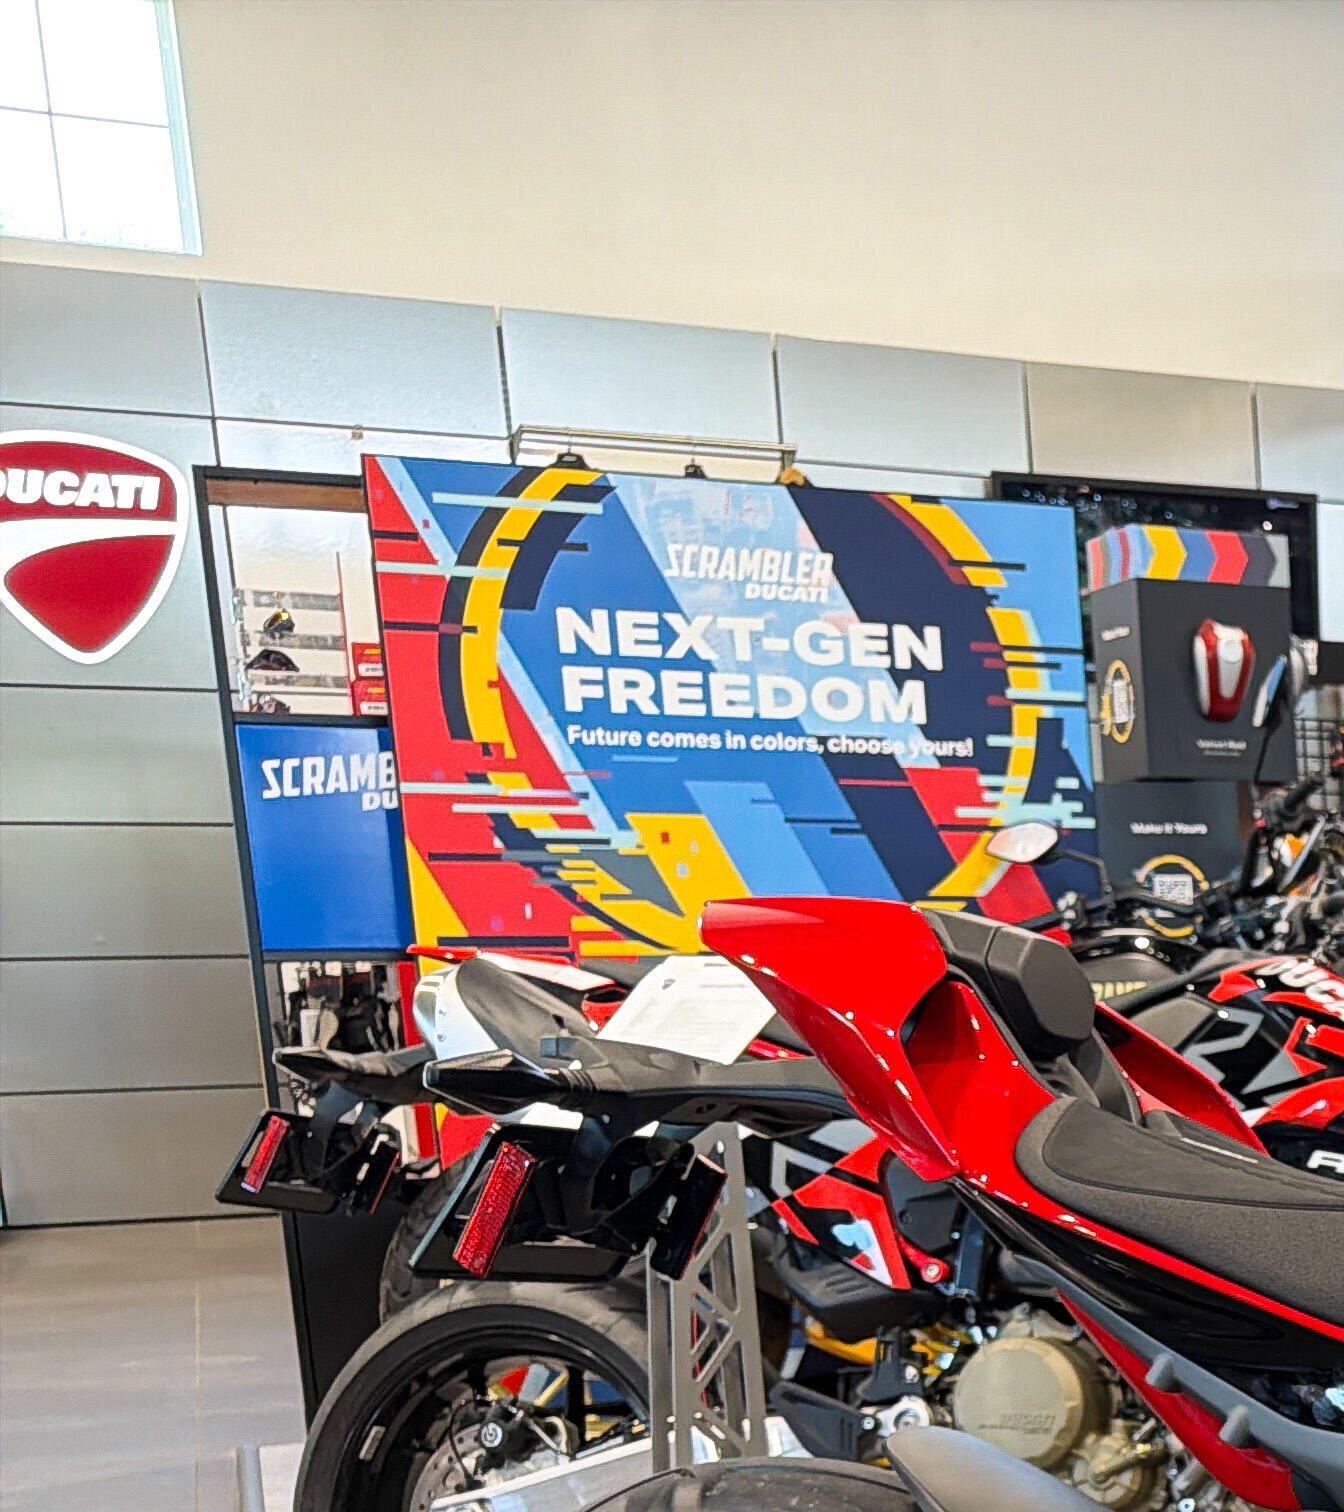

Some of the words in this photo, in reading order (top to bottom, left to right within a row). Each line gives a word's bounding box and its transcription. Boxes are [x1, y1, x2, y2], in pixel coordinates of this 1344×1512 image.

[0, 468, 161, 511] UCATI
[663, 543, 834, 589] SCRAMBLER
[744, 582, 830, 605] DUCATI
[554, 606, 944, 672] NEXT-GEN
[560, 664, 929, 726] FREEDOM
[567, 724, 640, 749] Future
[646, 730, 722, 751] comes
[724, 727, 746, 751] in
[749, 728, 825, 756] colors,
[827, 733, 903, 757] choose
[908, 737, 974, 761] yours!
